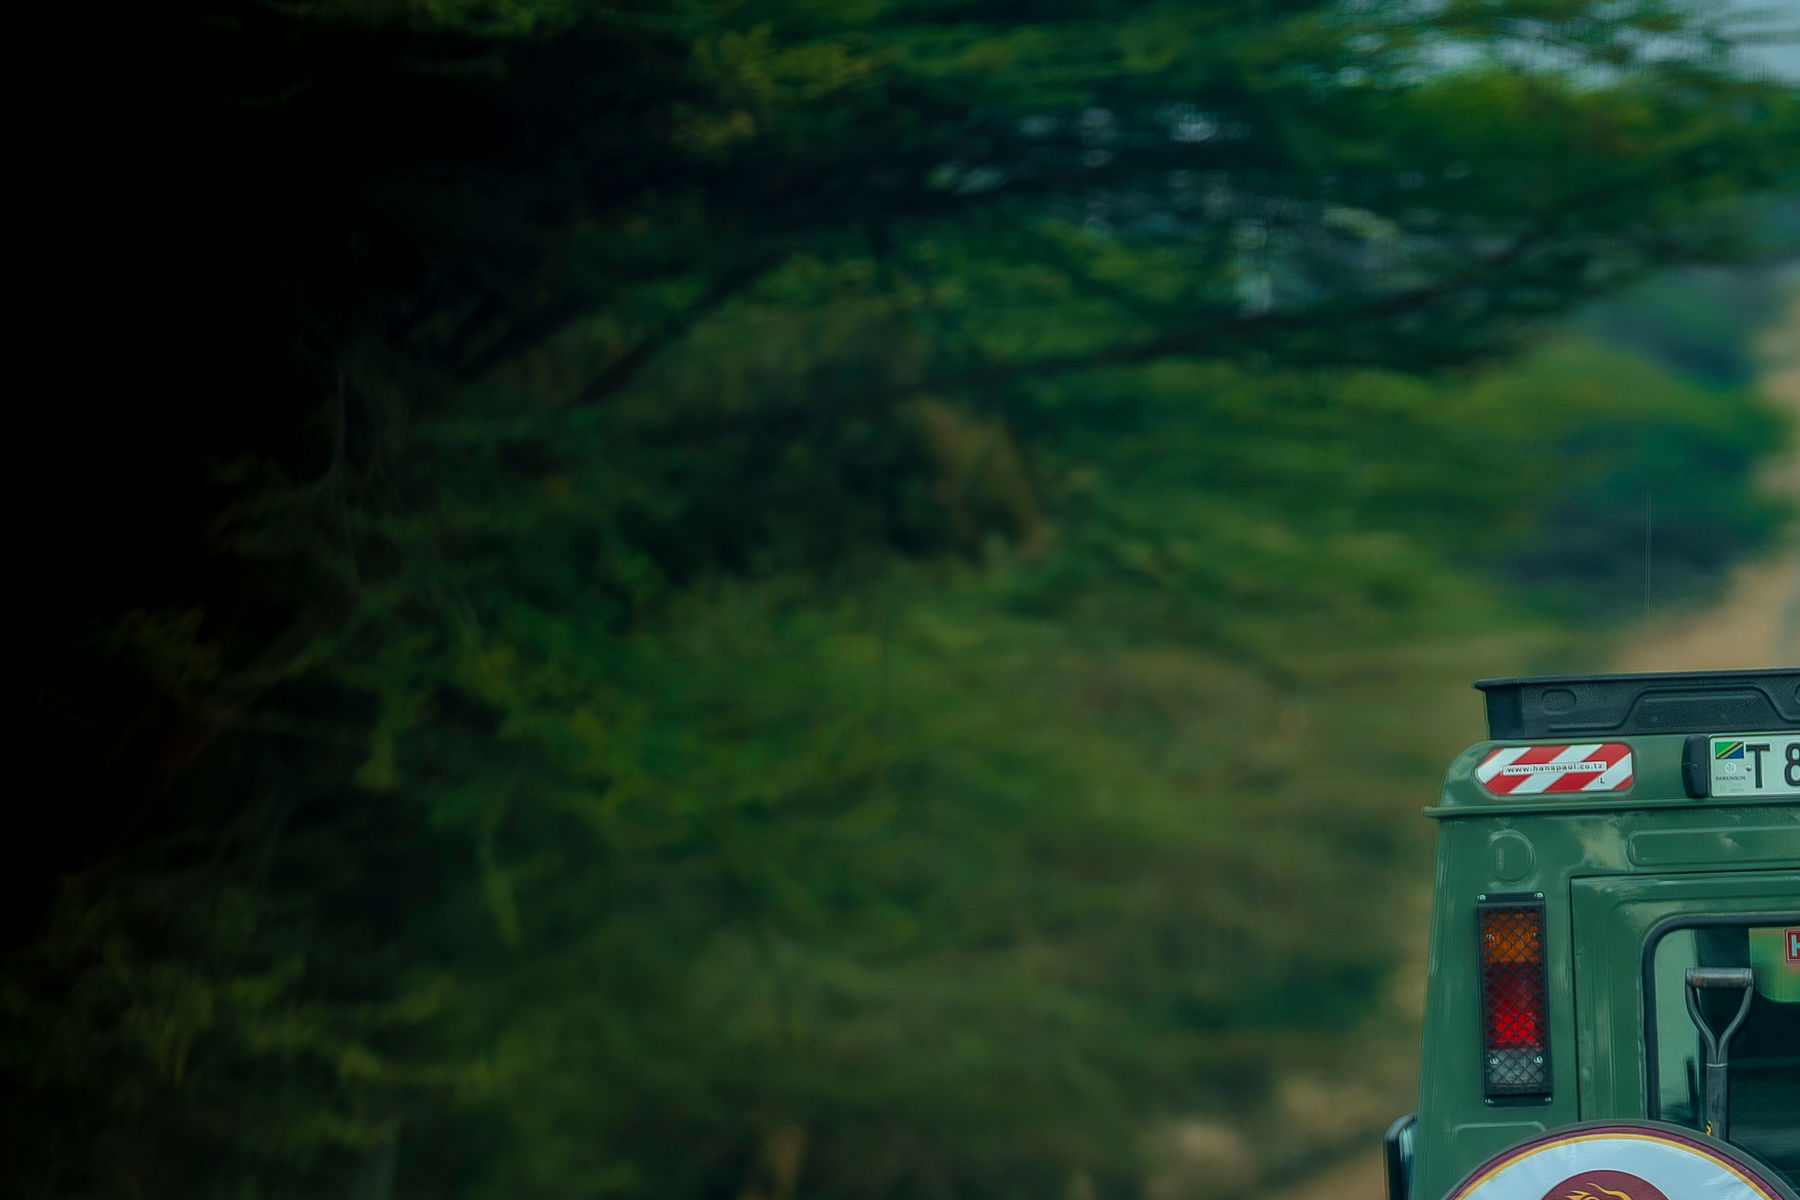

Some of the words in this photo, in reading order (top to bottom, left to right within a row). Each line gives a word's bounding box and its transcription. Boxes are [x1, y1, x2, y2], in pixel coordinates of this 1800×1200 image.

[1505, 763, 1603, 774] www.hanspaul.co.tz
[1745, 742, 1771, 789] T
[1599, 776, 1606, 785] L
